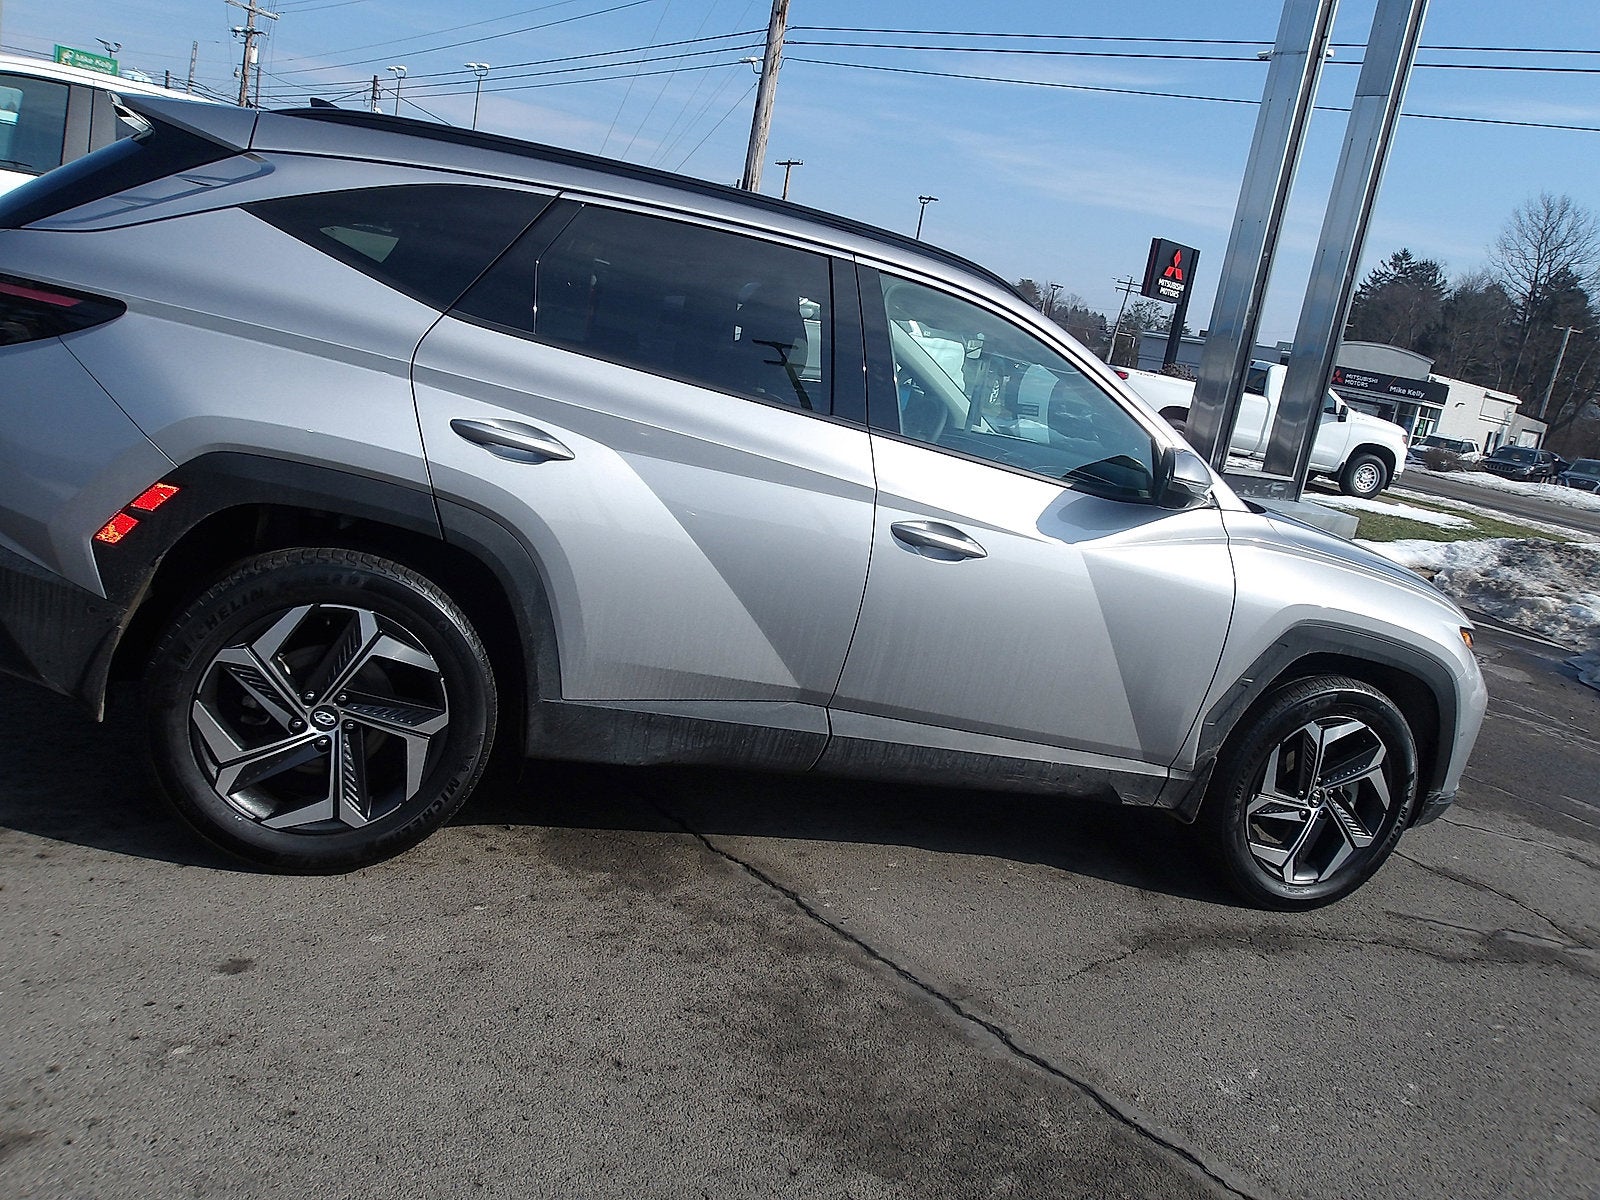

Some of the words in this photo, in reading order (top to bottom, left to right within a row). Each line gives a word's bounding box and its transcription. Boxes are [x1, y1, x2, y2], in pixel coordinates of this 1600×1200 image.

[1158, 278, 1184, 292] MITSUBISHI
[1160, 287, 1180, 299] MOTORS
[1344, 379, 1369, 388] MOTORS
[1346, 373, 1378, 384] MITSUBISHI
[1389, 385, 1406, 395] Mike
[1407, 389, 1425, 399] Kelly
